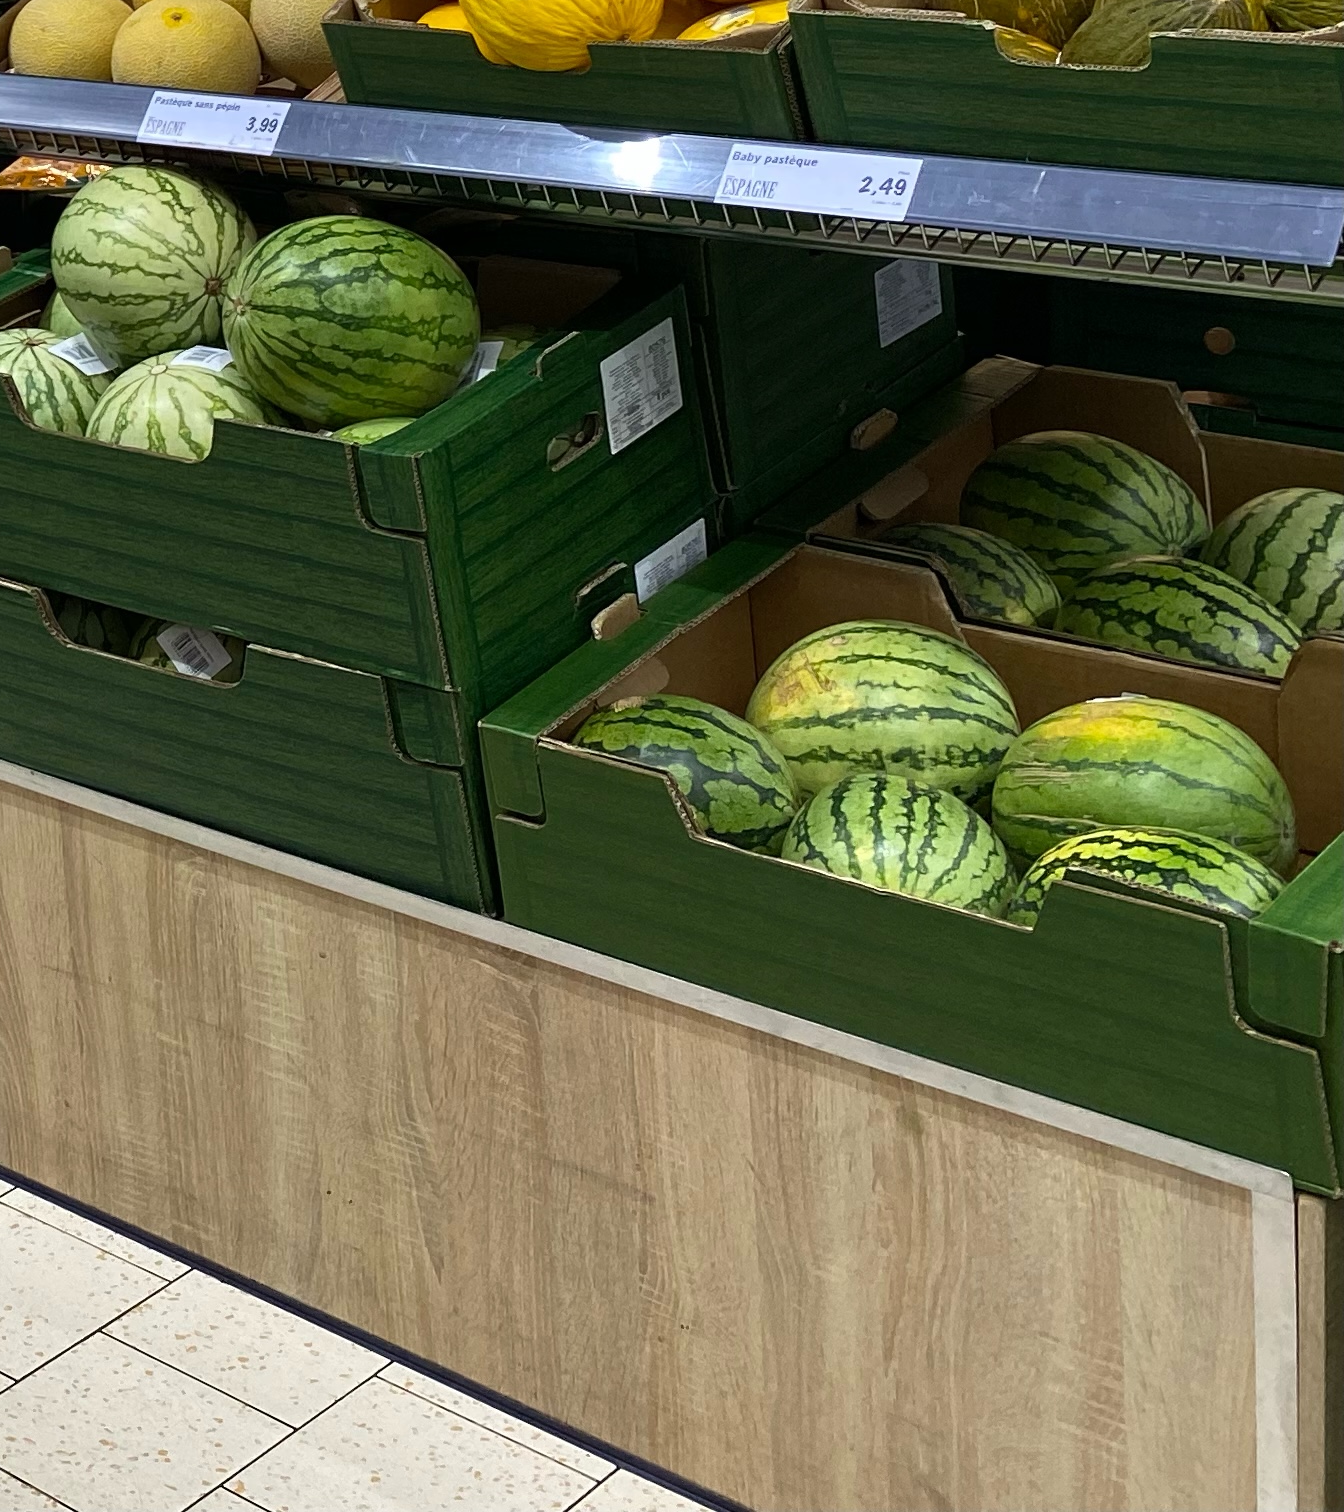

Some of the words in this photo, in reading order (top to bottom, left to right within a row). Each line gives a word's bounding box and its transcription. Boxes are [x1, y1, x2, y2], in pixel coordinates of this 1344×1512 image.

[154, 96, 192, 108] Pastèque
[195, 100, 214, 110] sans
[215, 101, 241, 113] pépin
[144, 116, 186, 136] ESPAGNE
[245, 116, 279, 133] 3,99
[732, 151, 761, 164] Baby
[764, 155, 819, 168] pastèque
[721, 178, 778, 199] ESPAGNE
[859, 176, 907, 196] 2,49
